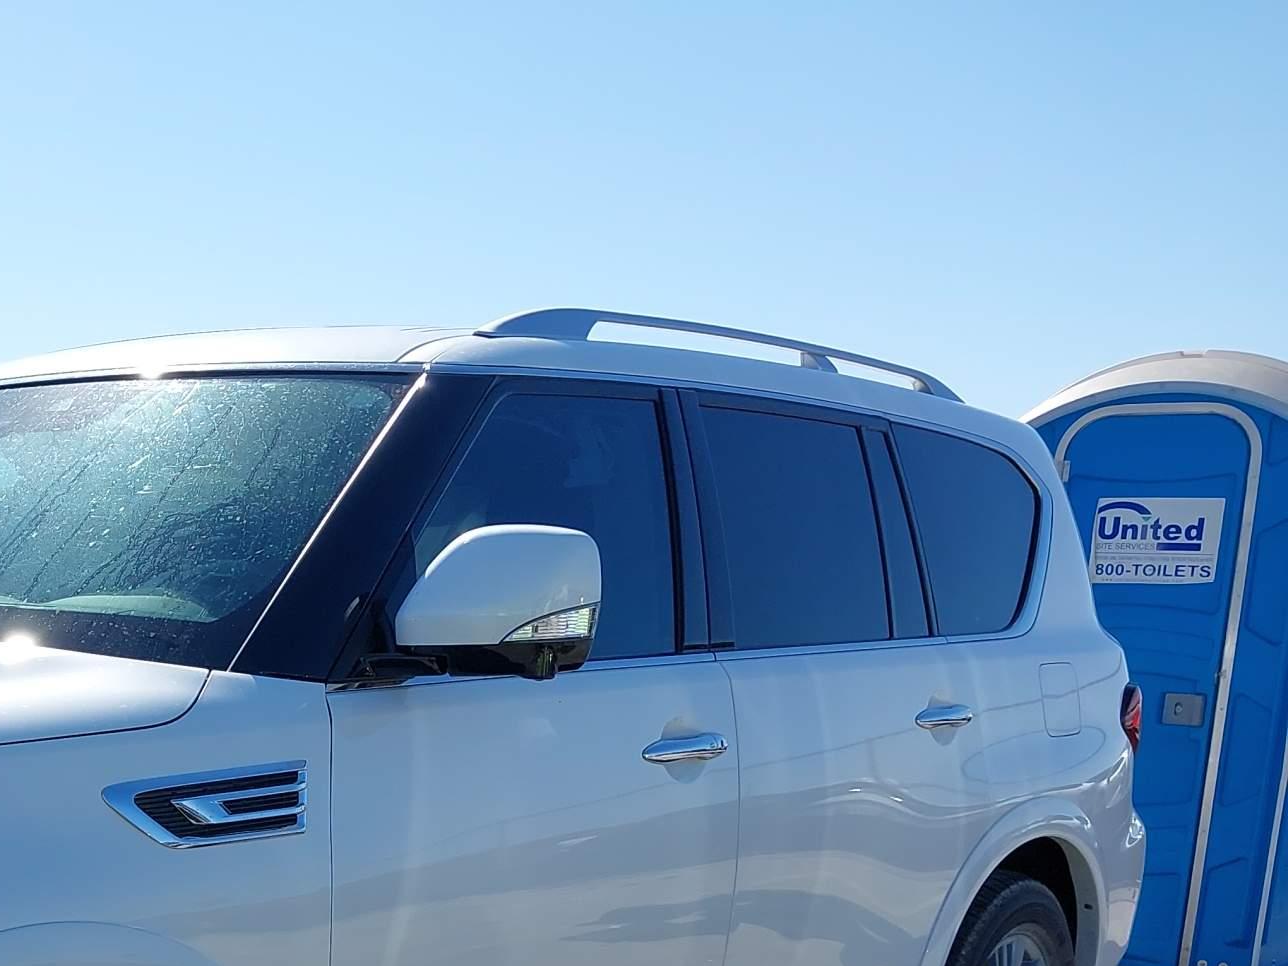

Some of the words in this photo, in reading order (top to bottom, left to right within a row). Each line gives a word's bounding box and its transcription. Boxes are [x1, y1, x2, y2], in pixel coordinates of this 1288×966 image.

[1098, 515, 1206, 542] United
[1116, 543, 1155, 551] SERVICES
[1095, 563, 1212, 578] 800-TOILETS
